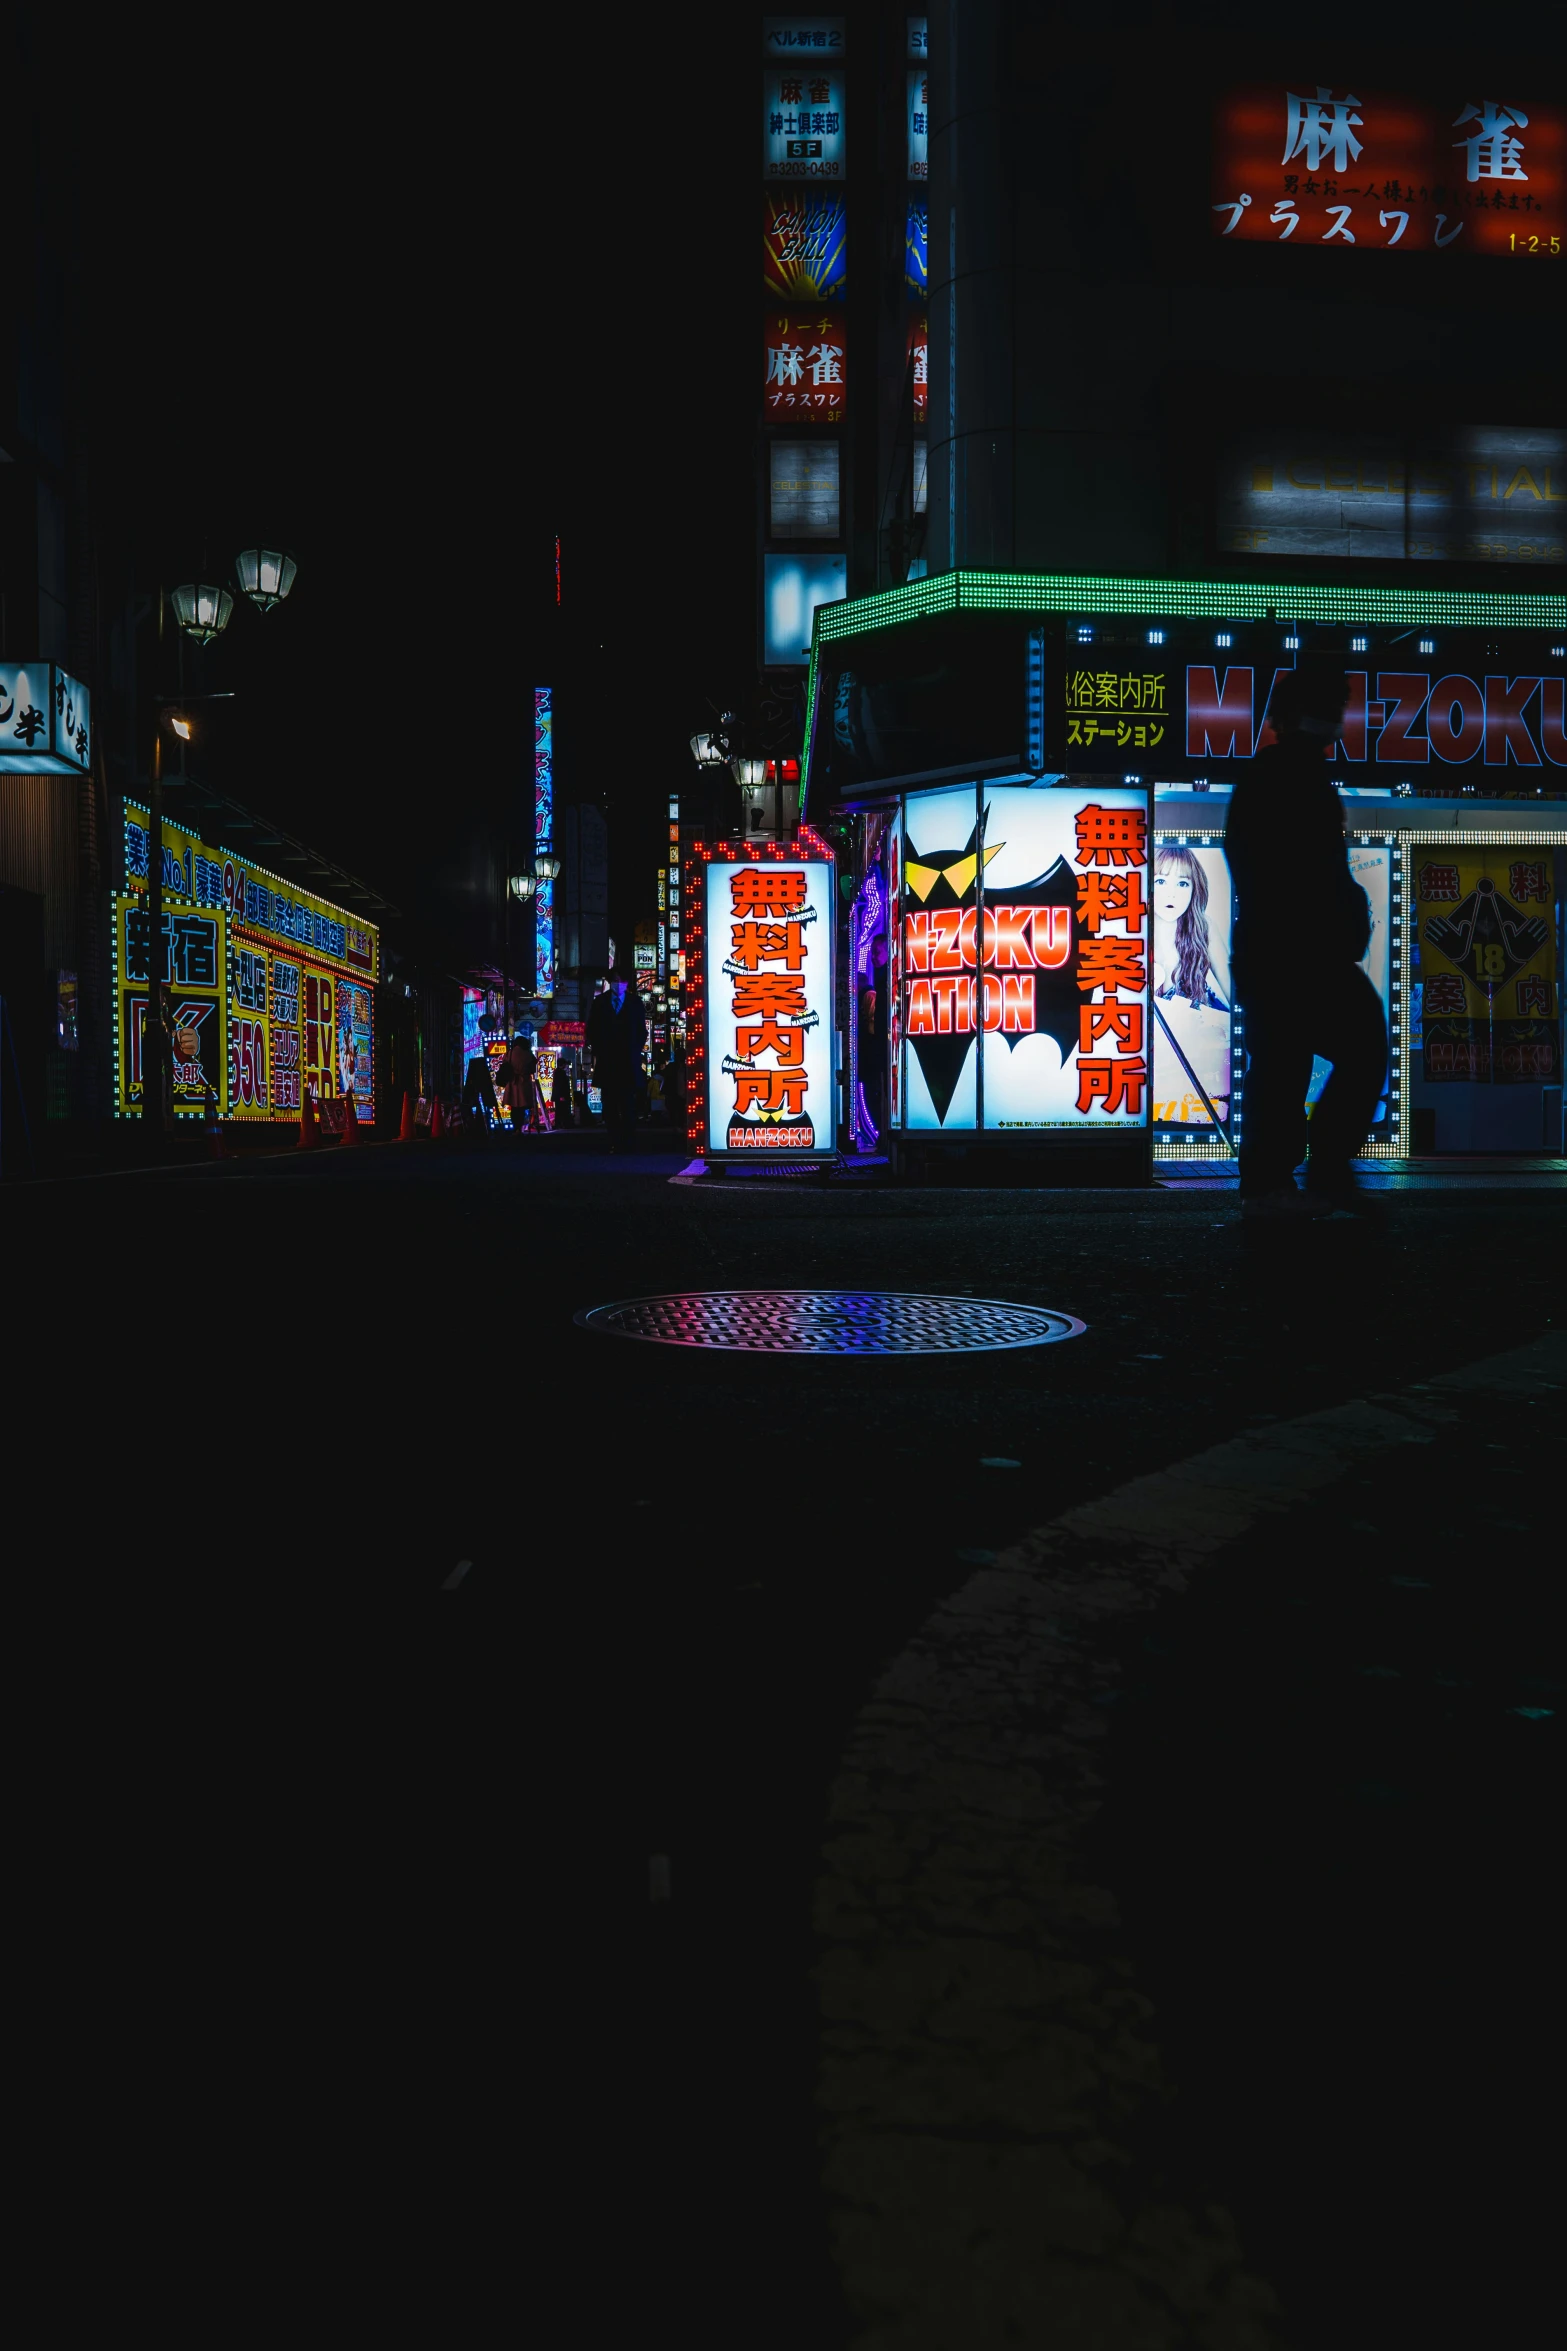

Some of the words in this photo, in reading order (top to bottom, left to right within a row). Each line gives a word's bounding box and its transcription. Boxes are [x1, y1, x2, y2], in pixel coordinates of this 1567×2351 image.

[768, 31, 841, 47] ベル新宿2
[780, 78, 831, 104] 麻雀
[1281, 86, 1528, 182] 麻雀
[792, 143, 817, 156] 5F
[779, 162, 839, 176] 3203-0439
[777, 236, 831, 262] BALL
[1509, 233, 1561, 255] 1-2-5
[778, 318, 833, 335] リーチ
[766, 342, 843, 386] 麻雀
[827, 411, 842, 422] 3F
[773, 481, 837, 490] CELESTIAL
[1066, 671, 1166, 709] 俗案内所
[1067, 719, 1165, 748] ステーション
[1074, 804, 1147, 1115] 無料案内所
[1472, 942, 1505, 970] 18
[730, 868, 808, 1115] 無料案内所
[905, 974, 1036, 1035] ATION
[274, 1029, 300, 1068] エリア
[729, 1127, 814, 1149] MAN-ZOKU
